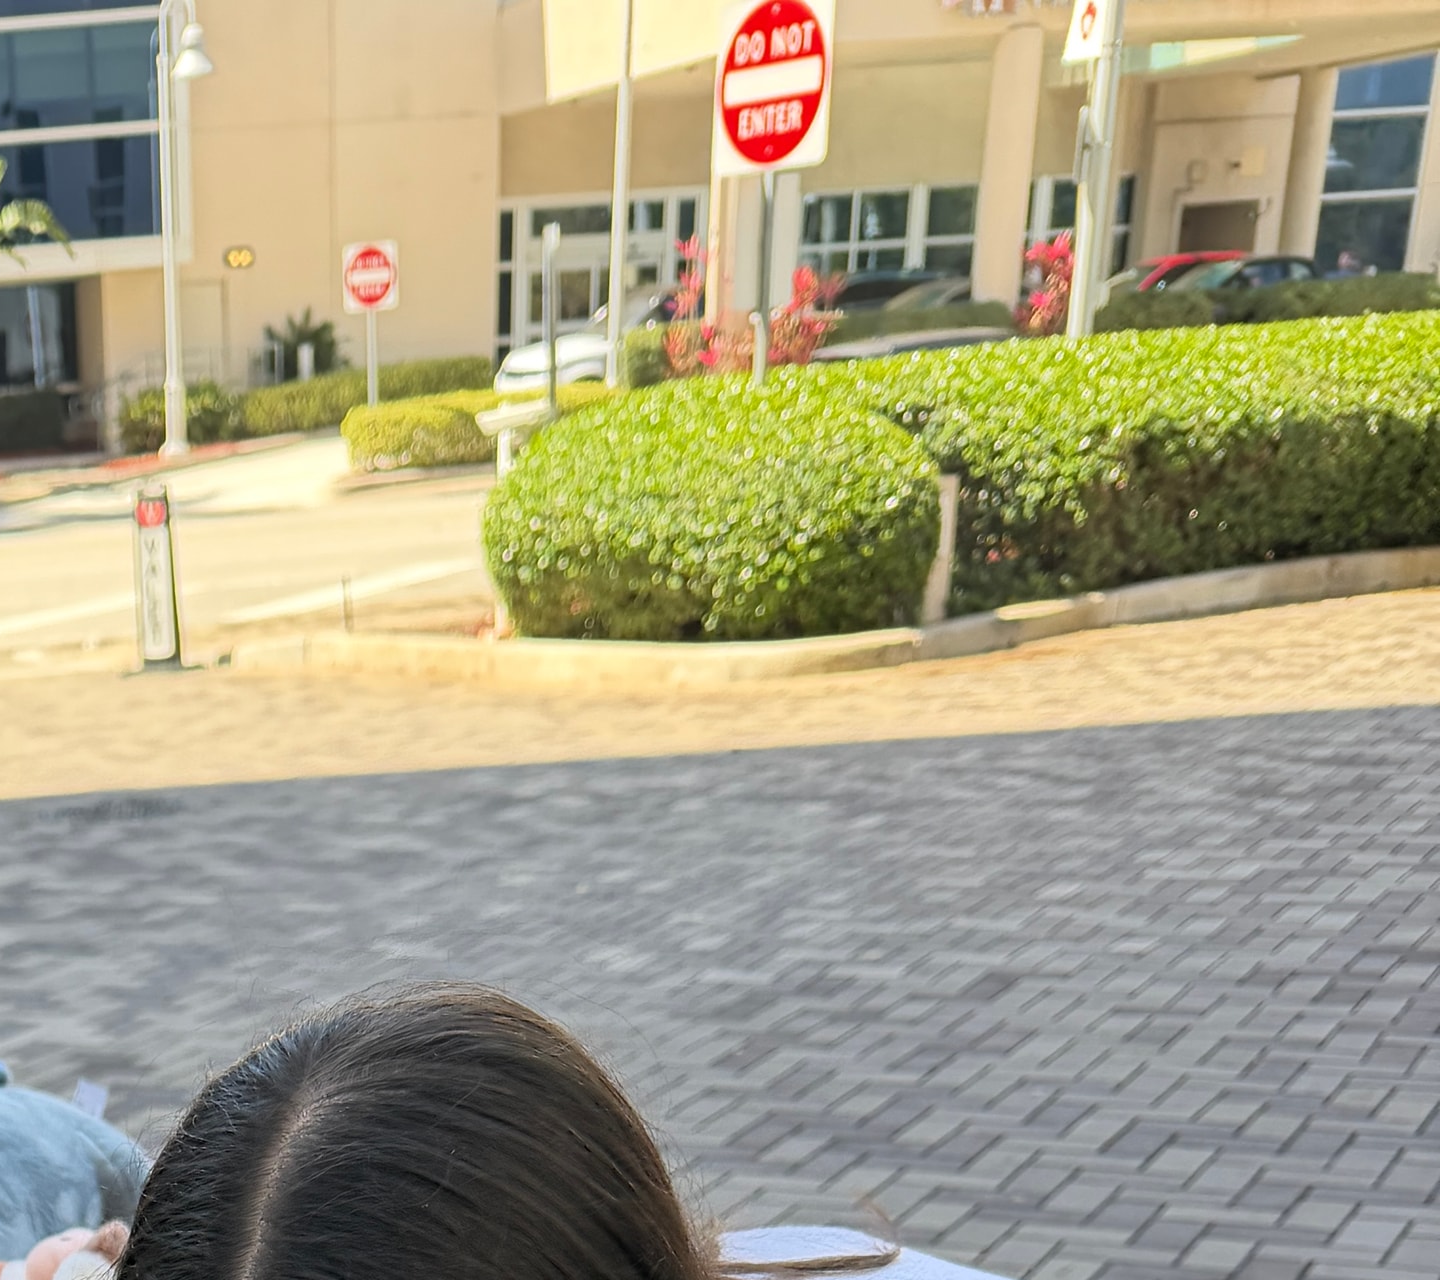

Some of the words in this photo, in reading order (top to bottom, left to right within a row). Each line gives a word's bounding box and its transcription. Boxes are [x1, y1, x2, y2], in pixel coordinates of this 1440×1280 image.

[734, 30, 766, 67] DO
[770, 19, 816, 60] NOT
[737, 99, 804, 142] ENTER
